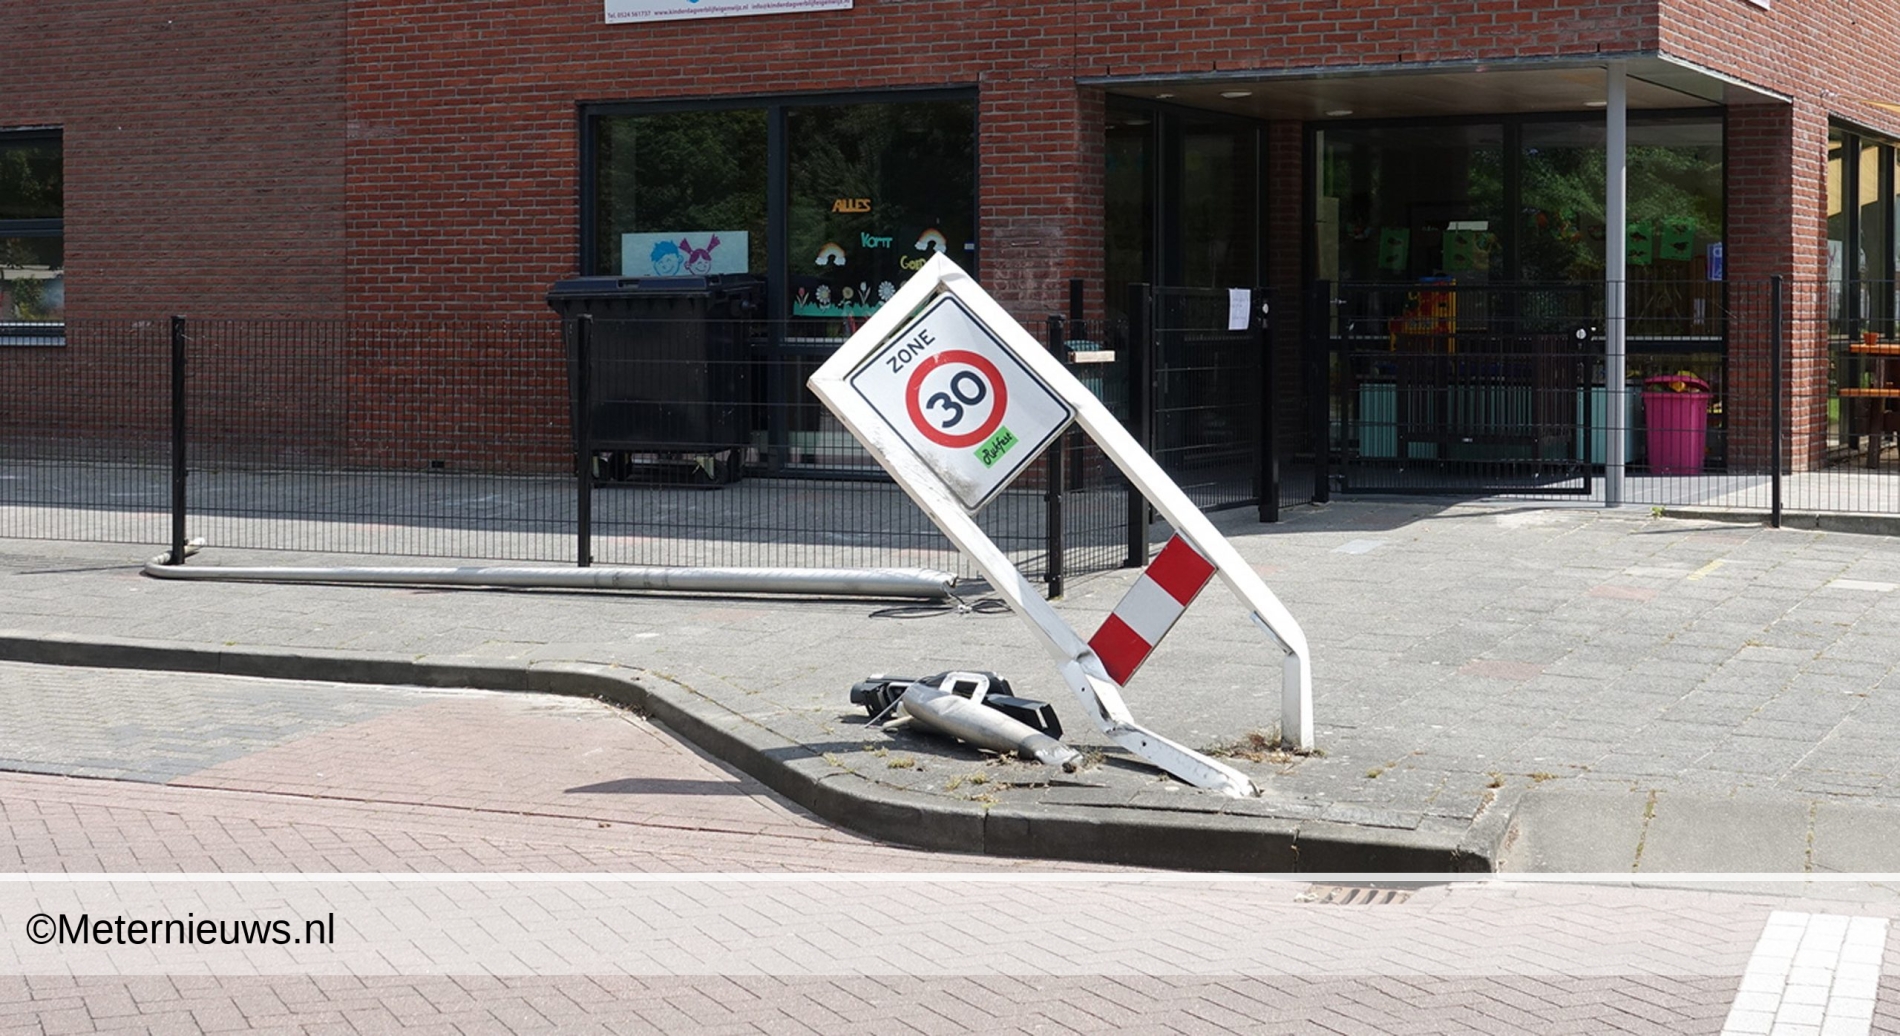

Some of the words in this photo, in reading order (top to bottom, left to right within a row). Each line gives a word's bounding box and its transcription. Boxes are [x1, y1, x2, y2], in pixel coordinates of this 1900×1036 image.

[832, 198, 871, 213] ALLES
[886, 329, 936, 373] ZONE
[926, 371, 987, 428] 30
